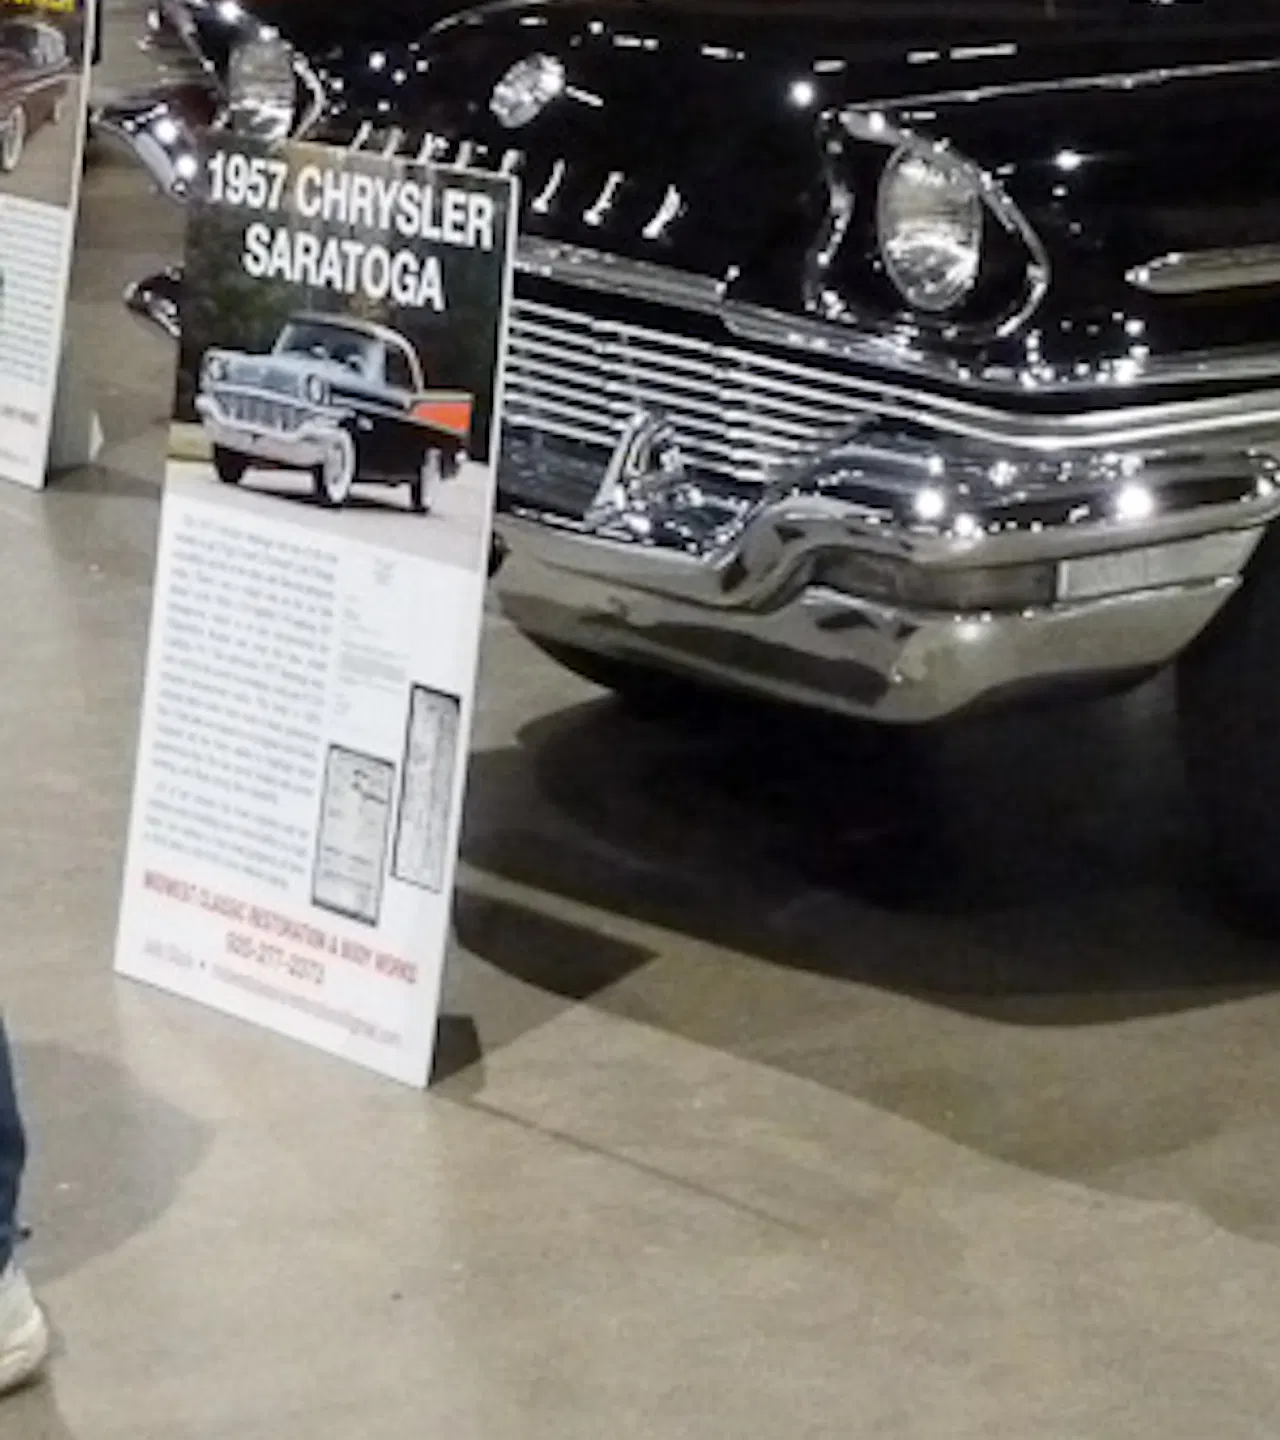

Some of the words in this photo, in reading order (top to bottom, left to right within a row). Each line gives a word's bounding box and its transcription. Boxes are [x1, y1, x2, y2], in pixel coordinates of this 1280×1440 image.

[206, 150, 288, 211] 1957
[295, 165, 495, 252] CHRYSLER
[242, 222, 446, 313] SARATOGA
